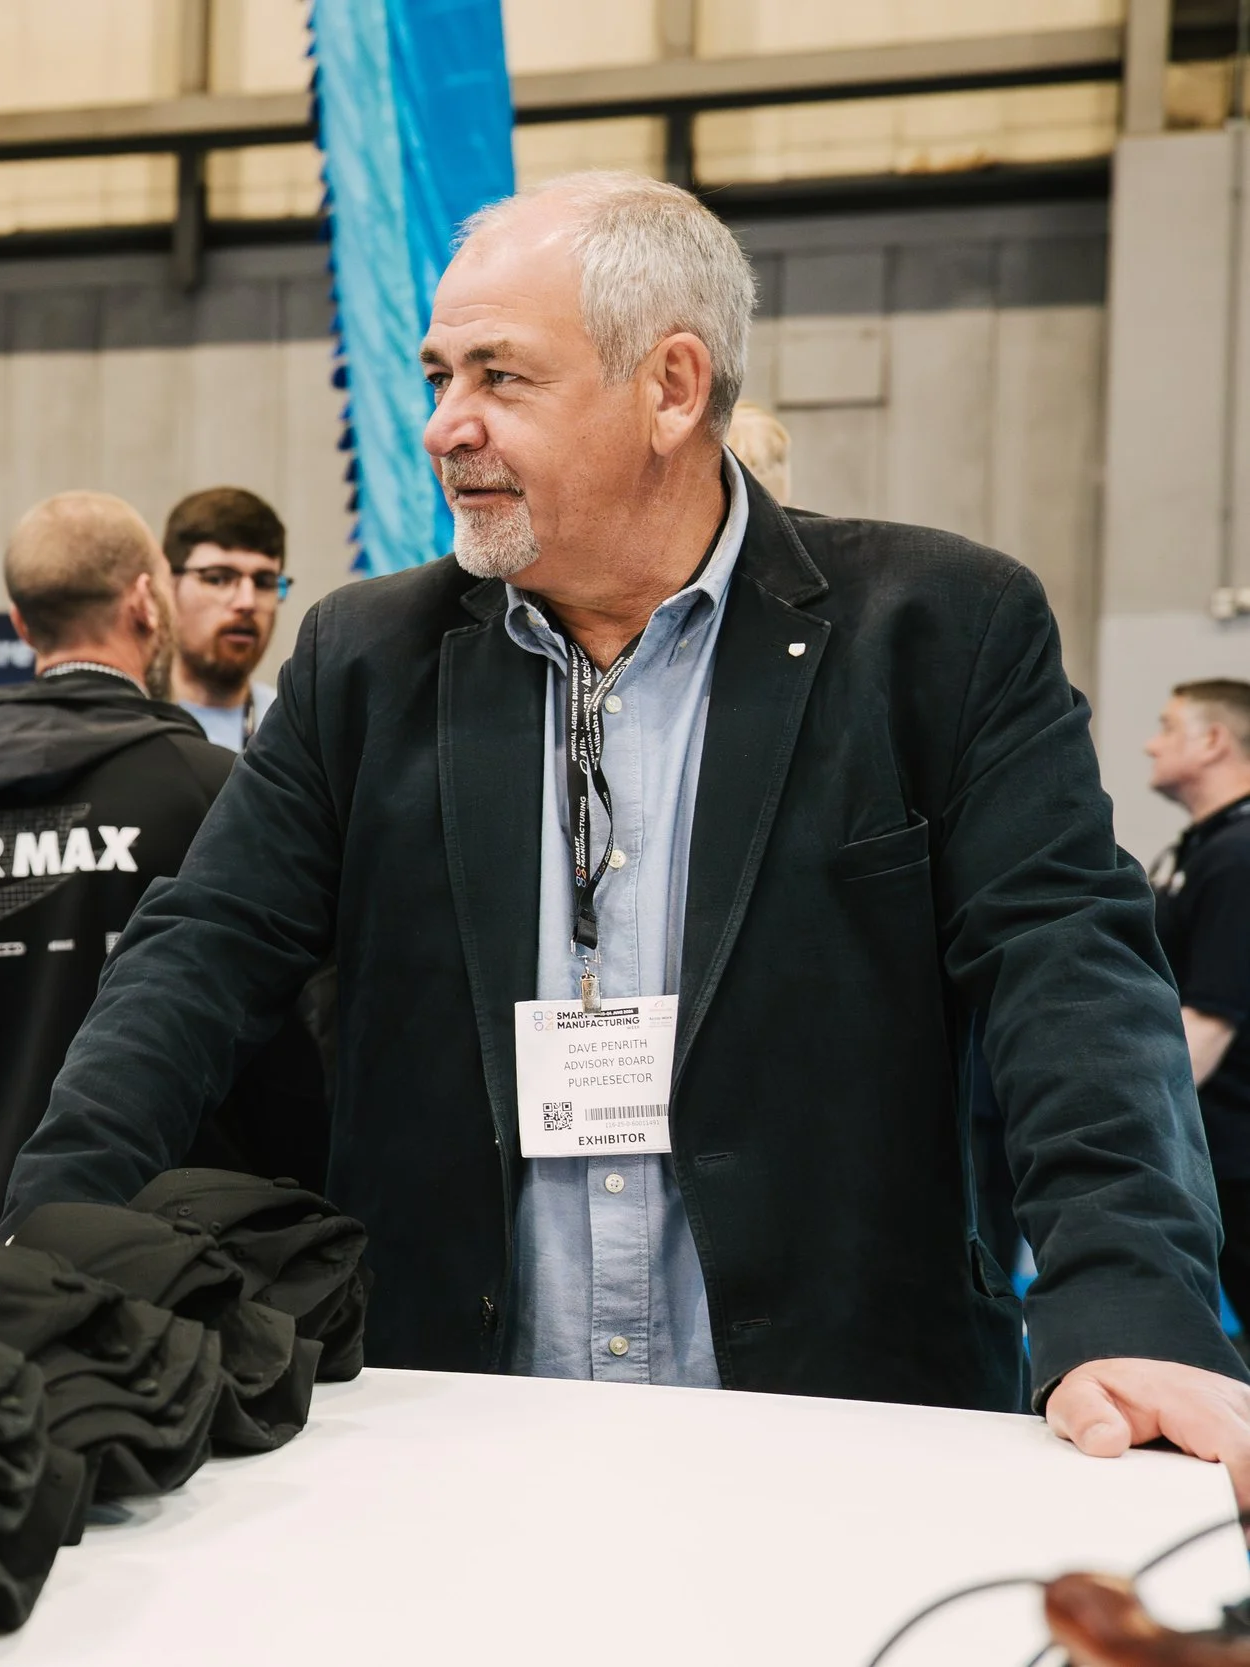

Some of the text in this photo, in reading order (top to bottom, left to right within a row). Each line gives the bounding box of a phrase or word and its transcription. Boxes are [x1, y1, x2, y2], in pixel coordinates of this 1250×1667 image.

[581, 656, 591, 687] Accio
[579, 796, 587, 867] MANUFACTURING
[556, 1012, 588, 1020] SMAR
[557, 1016, 640, 1029] MANUFACTURING
[568, 1039, 648, 1054] DAVE PENRITH
[564, 1055, 655, 1071] ADVISORY BOARD
[568, 1073, 653, 1087] PURPLESECTOR
[578, 1133, 646, 1146] EXHIBITOR
